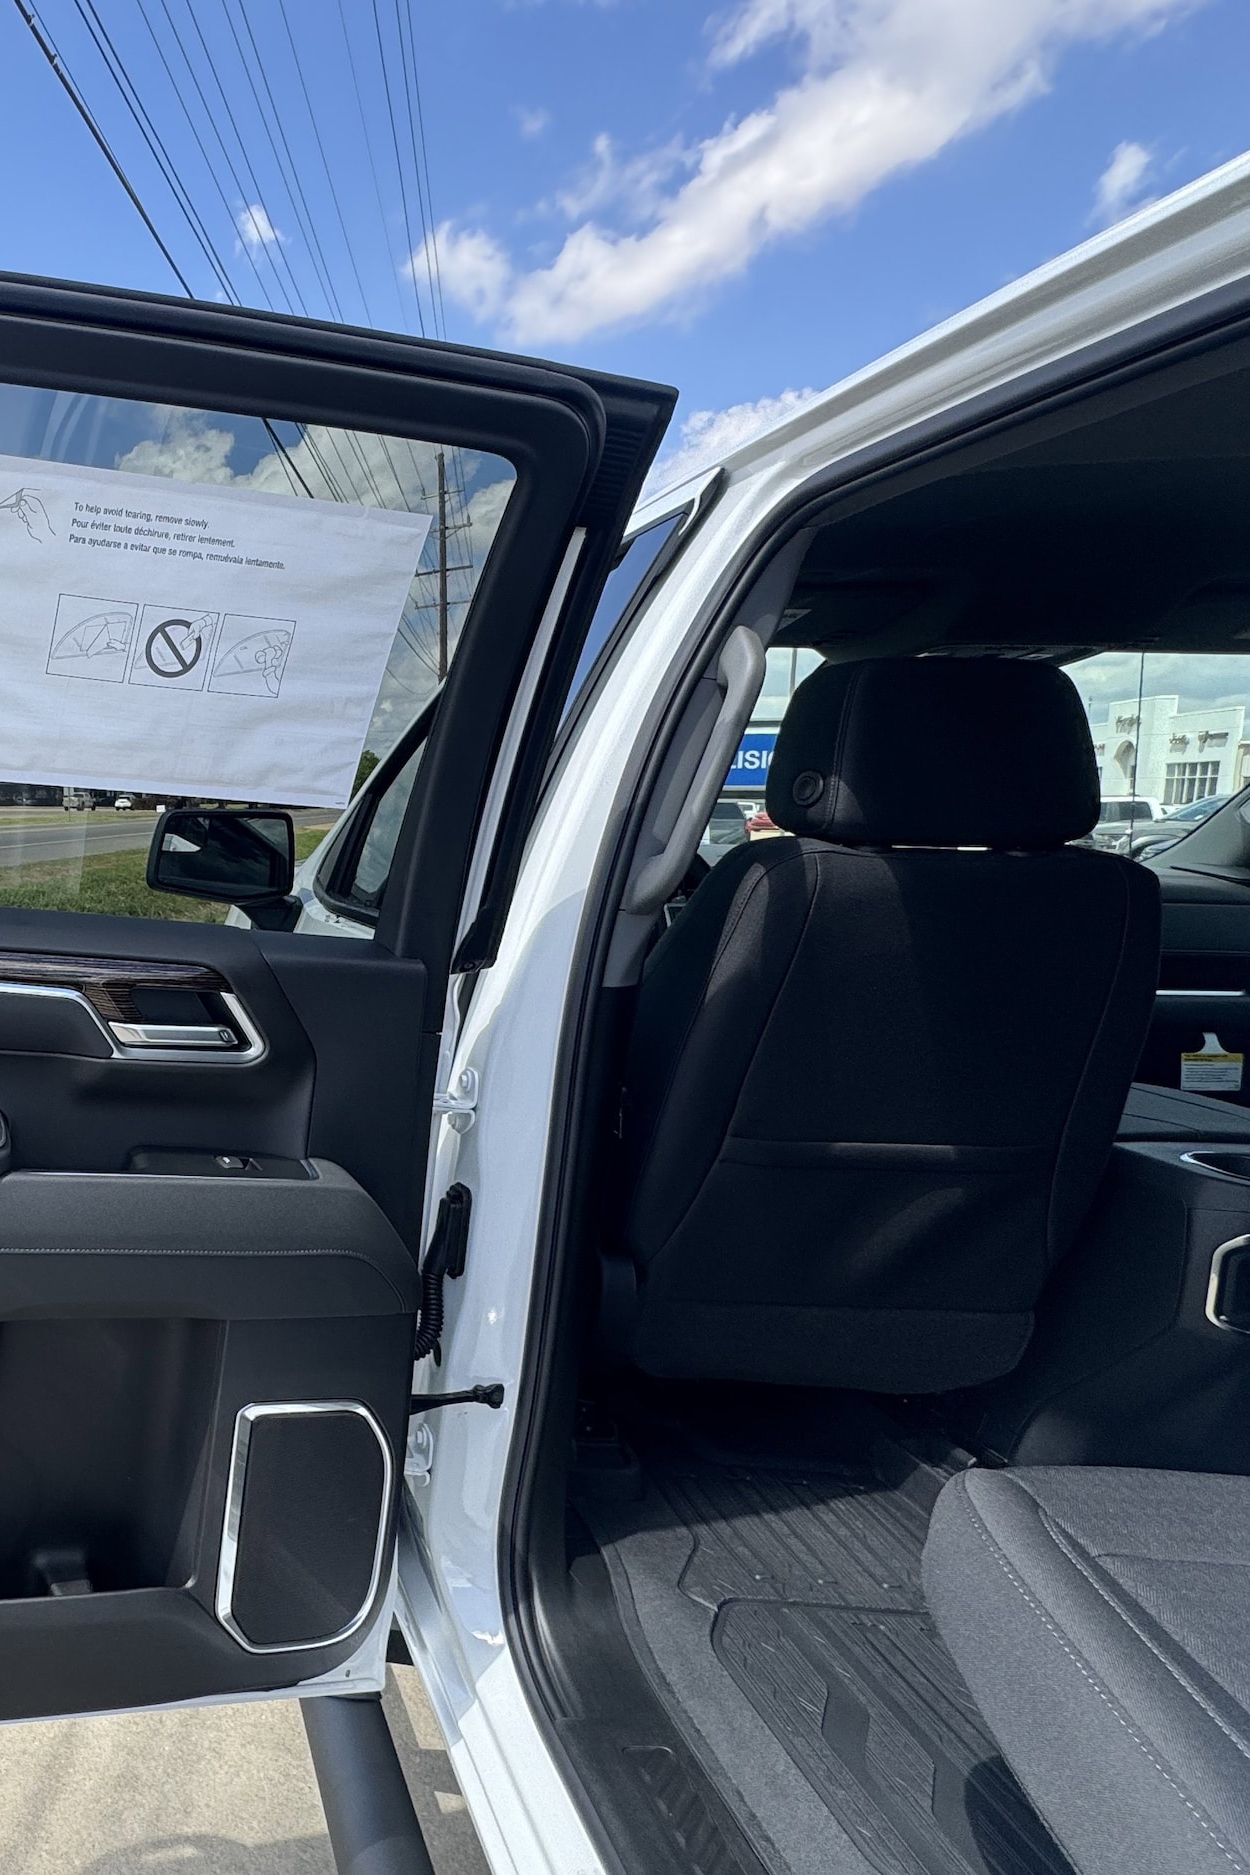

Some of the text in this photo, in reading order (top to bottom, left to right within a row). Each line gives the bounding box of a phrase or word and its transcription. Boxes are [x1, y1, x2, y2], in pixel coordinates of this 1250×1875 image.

[74, 502, 210, 530] To help avoid tearing, remove slowly.
[71, 518, 236, 548] Pour éviter toute déchirure, retirer lentement.
[68, 534, 86, 545] Para
[87, 538, 121, 549] ayudarse
[123, 542, 128, 550] a
[130, 542, 151, 552] evitar
[152, 546, 167, 556] que
[168, 548, 177, 556] se
[178, 550, 204, 561] rompa,
